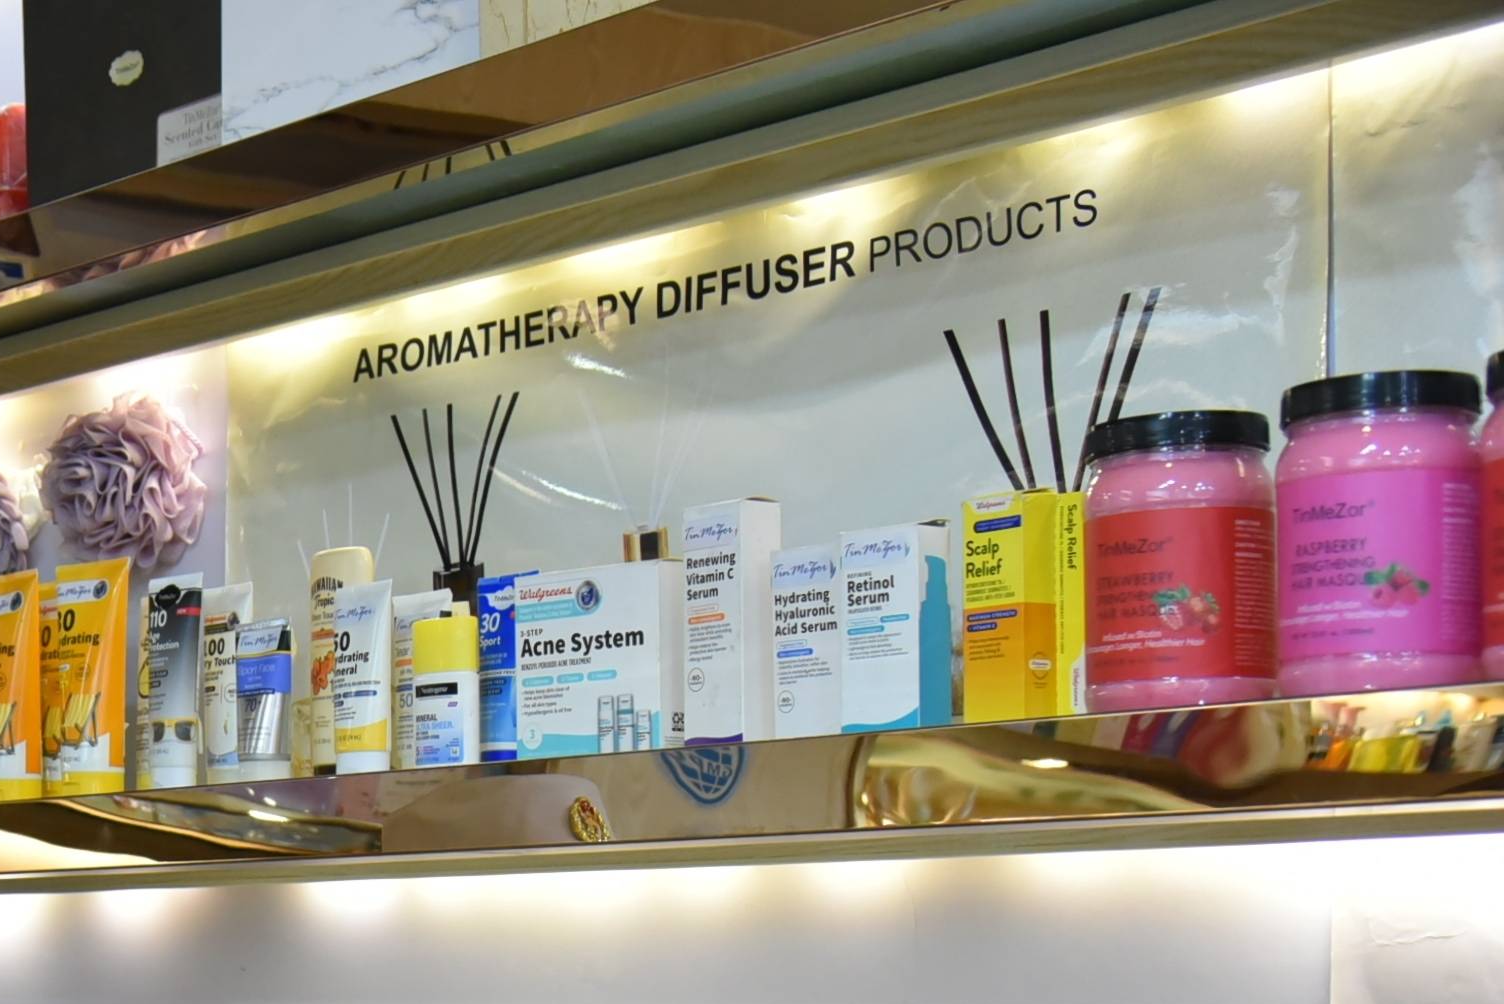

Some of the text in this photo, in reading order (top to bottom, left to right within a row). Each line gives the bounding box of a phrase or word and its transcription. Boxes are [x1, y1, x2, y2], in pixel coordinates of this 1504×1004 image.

[353, 187, 1099, 383] AROMATHERAPY DIFFUSER PRODUCTS
[1064, 503, 1077, 570] Scalp Relief
[965, 538, 1000, 560] Scalp
[686, 551, 736, 571] Renewing
[965, 558, 1003, 579] Relief
[686, 568, 735, 587] Vitamin C
[847, 575, 895, 593] Retinol
[686, 585, 719, 601] Serum
[774, 588, 830, 607] Hydrating
[847, 590, 890, 607] Serum
[150, 609, 167, 628] 110
[480, 612, 500, 633] 30
[775, 604, 836, 622] Hyaluronic
[774, 619, 838, 637] Acid Serum
[60, 632, 100, 647] drating
[479, 635, 501, 650] Sport
[520, 629, 645, 659] Acne System
[214, 654, 237, 667] Touch
[336, 664, 358, 676] neral
